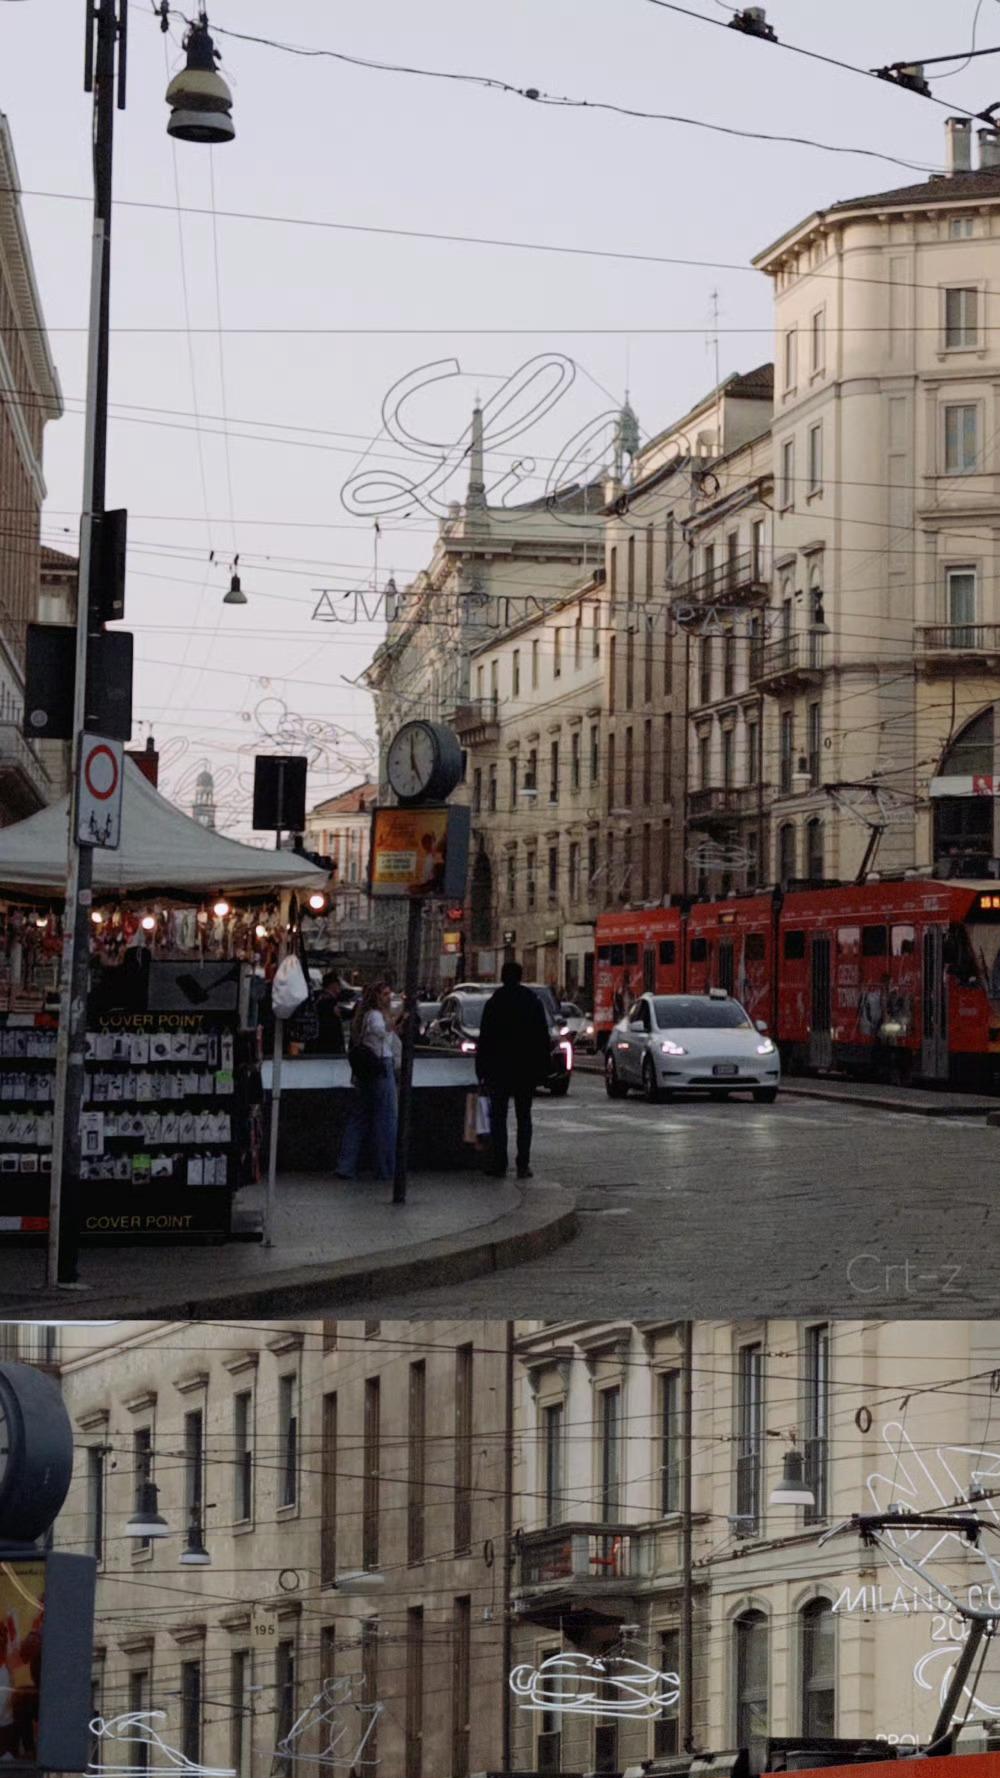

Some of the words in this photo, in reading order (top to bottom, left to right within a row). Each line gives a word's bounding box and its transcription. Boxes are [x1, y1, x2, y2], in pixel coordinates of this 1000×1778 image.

[158, 1015, 203, 1026] POINT
[86, 1216, 141, 1229] COVER
[146, 1216, 193, 1228] POINT
[254, 1624, 276, 1636] 195
